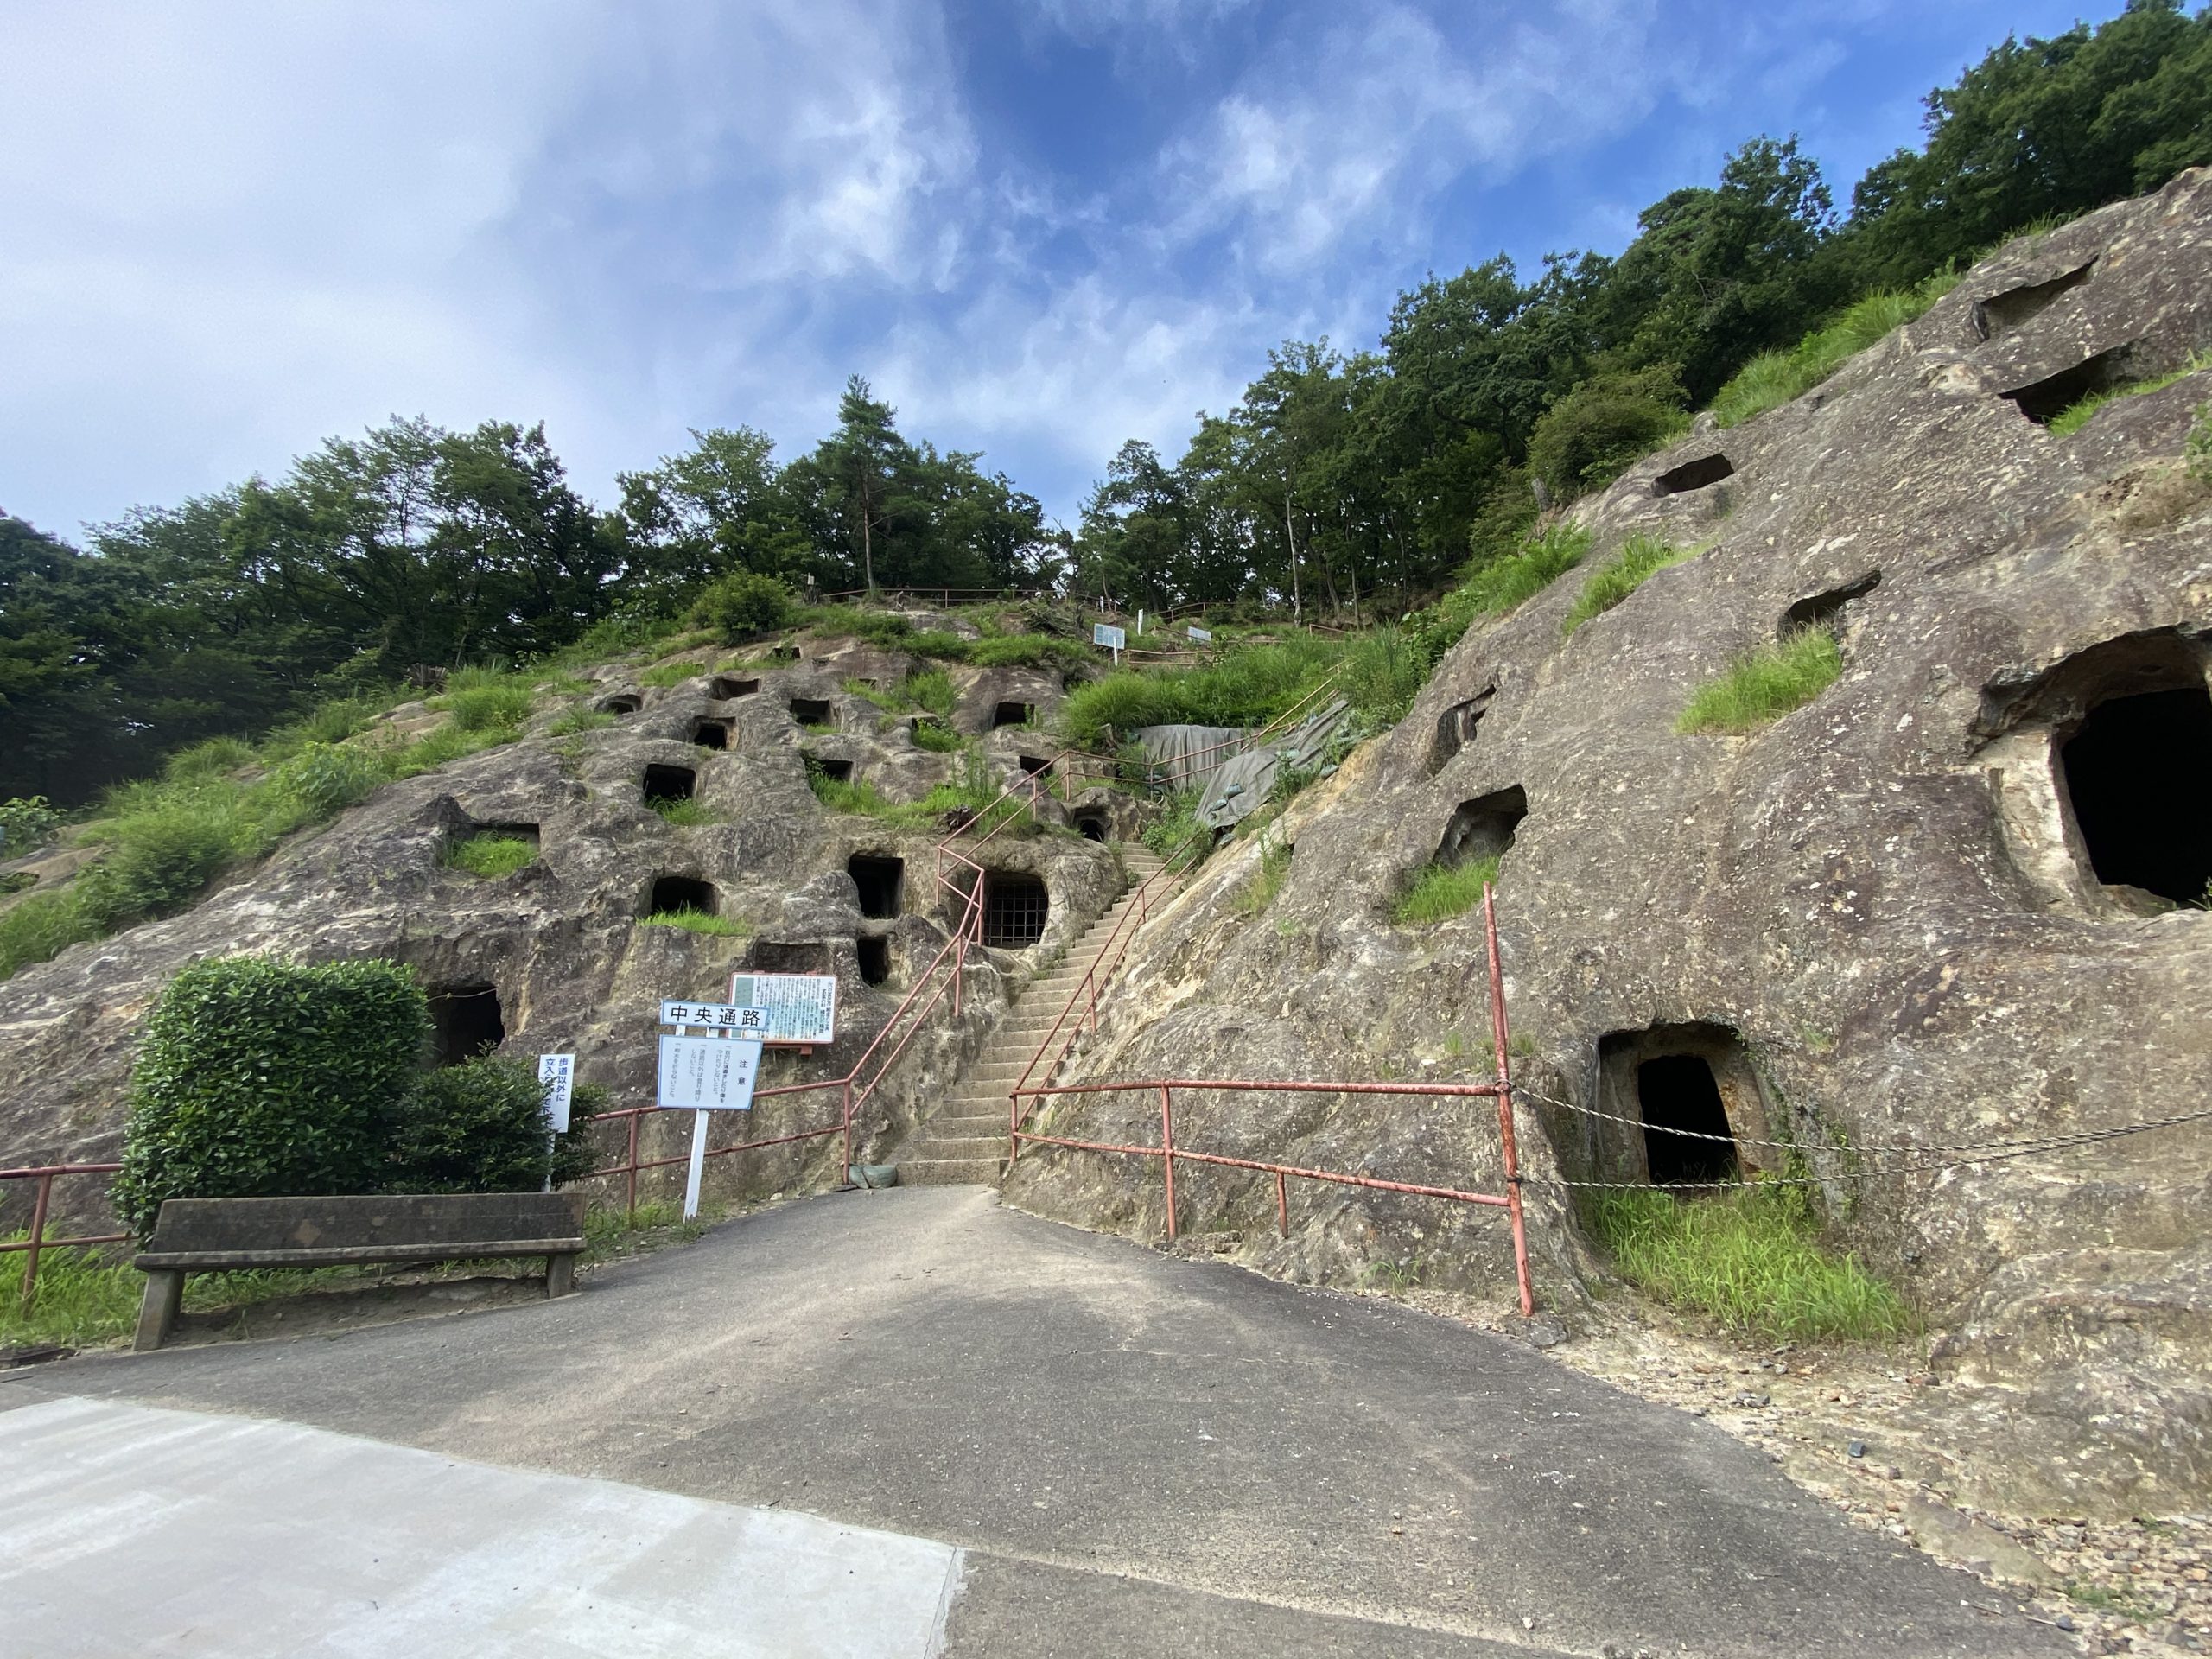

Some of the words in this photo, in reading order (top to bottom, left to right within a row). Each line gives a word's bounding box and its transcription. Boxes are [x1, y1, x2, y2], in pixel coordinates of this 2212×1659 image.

[671, 1005, 760, 1027] 中央通路
[556, 1058, 568, 1102] 歩道以外に
[737, 1060, 747, 1085] 注意
